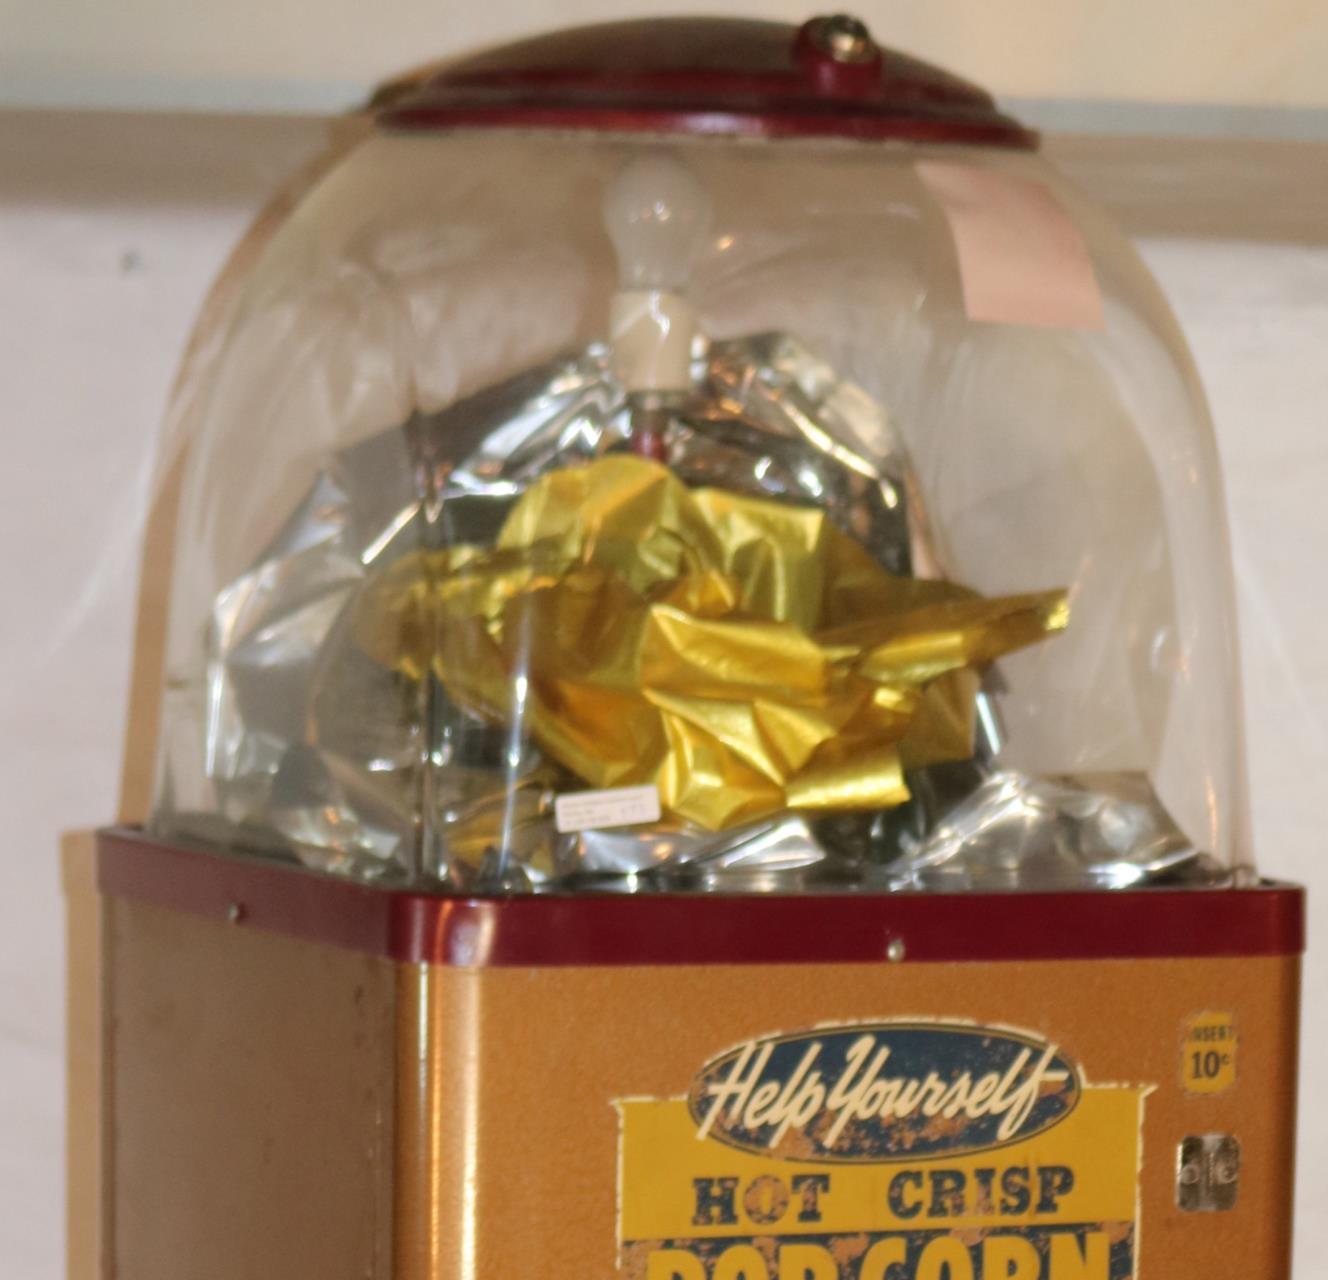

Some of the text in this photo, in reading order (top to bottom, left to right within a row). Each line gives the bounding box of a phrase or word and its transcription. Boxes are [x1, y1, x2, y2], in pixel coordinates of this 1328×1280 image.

[1191, 1024, 1233, 1043] NSERT
[695, 1034, 1070, 1150] Help Yourself
[691, 1165, 1075, 1226] HOT CRISP
